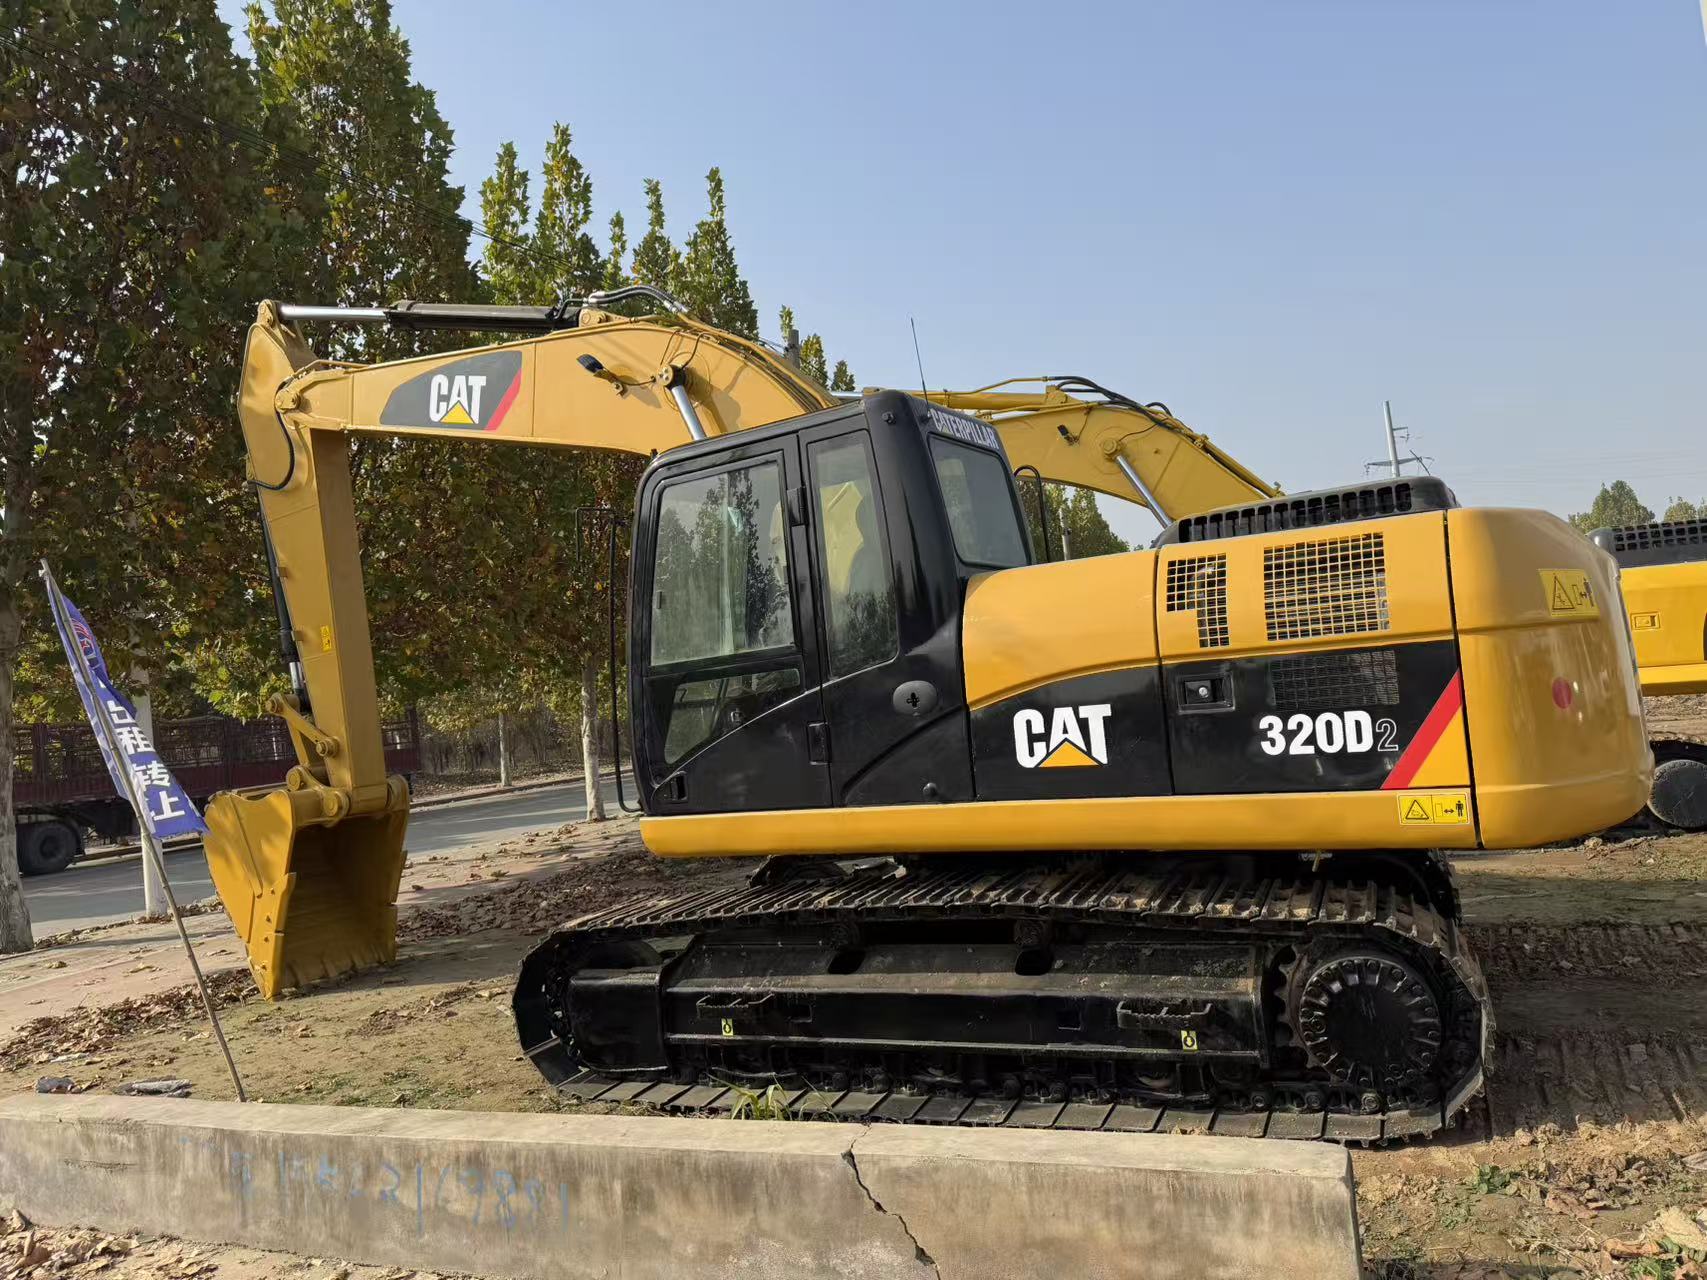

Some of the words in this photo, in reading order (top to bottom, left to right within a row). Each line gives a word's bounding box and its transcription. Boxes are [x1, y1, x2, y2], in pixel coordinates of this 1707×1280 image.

[429, 374, 487, 424] CAT
[929, 408, 1000, 450] CATERPILLAR
[1013, 704, 1112, 768] CAT
